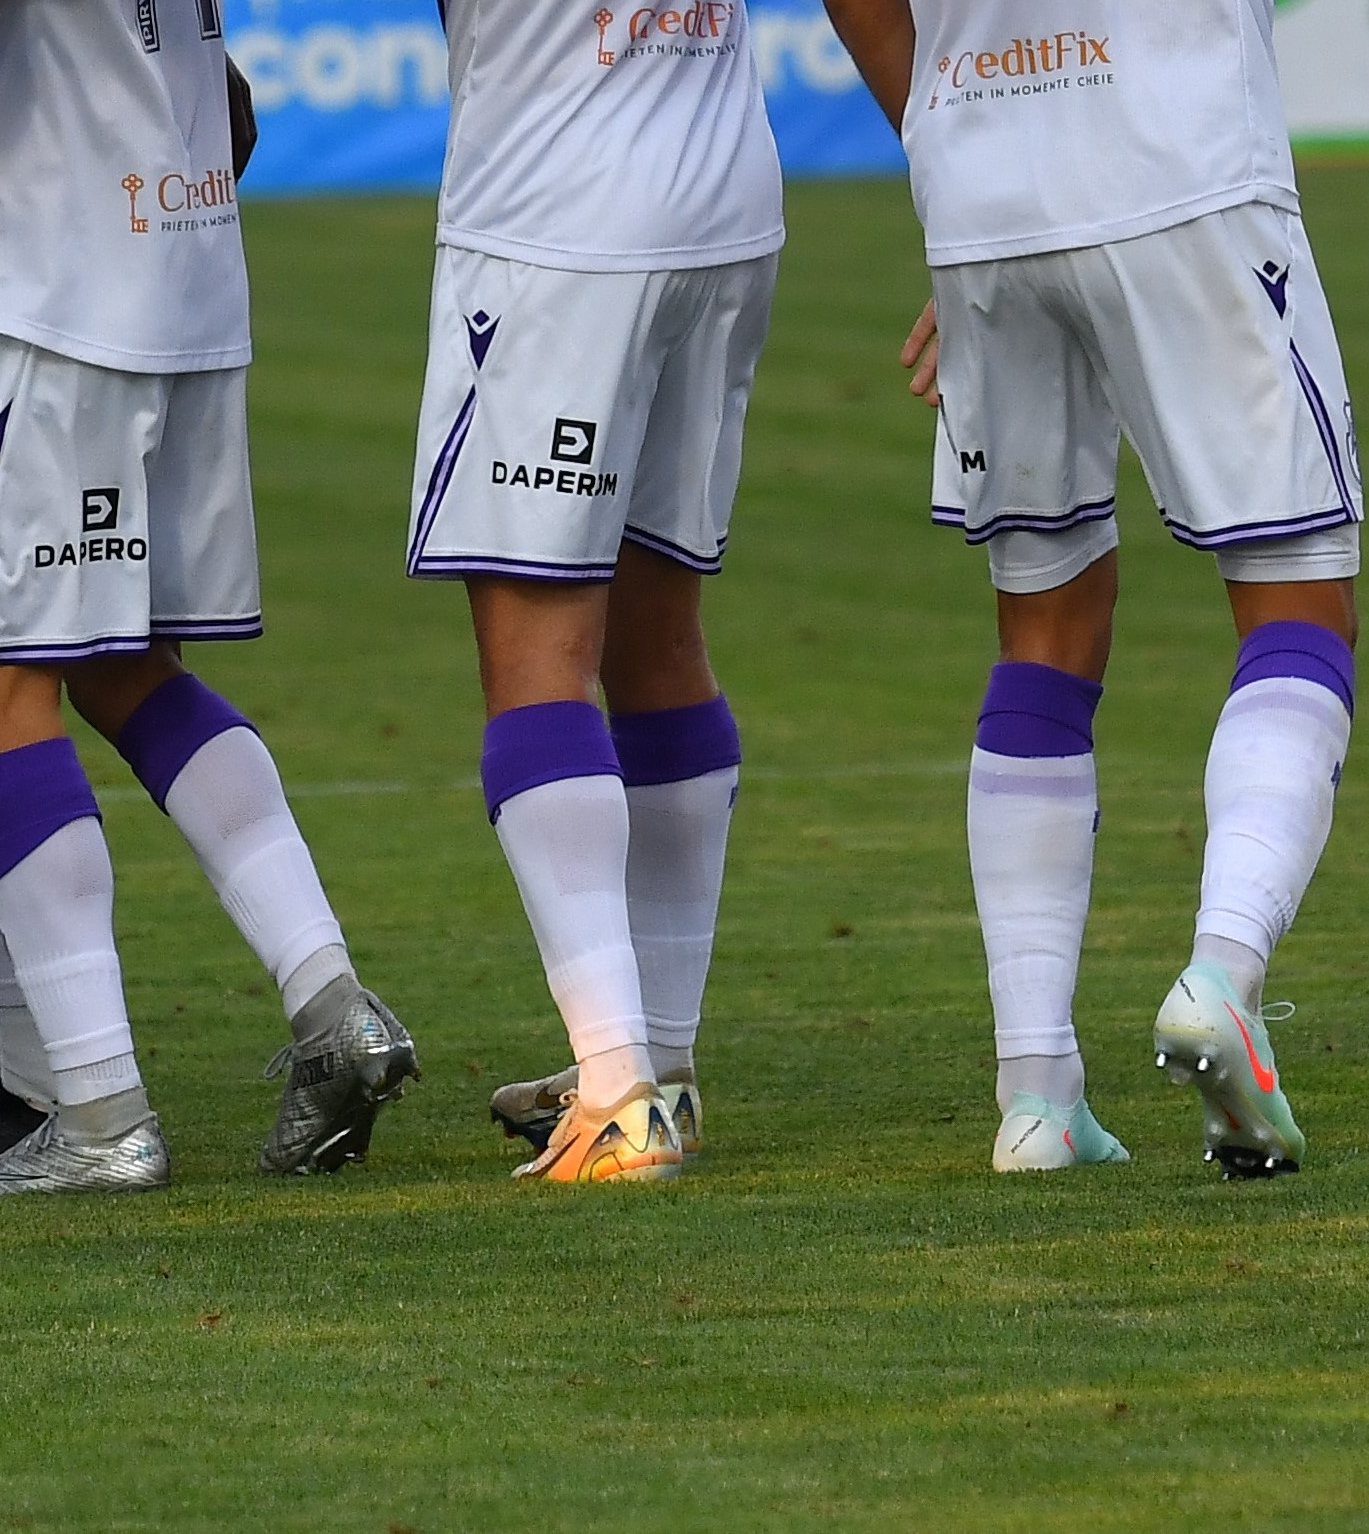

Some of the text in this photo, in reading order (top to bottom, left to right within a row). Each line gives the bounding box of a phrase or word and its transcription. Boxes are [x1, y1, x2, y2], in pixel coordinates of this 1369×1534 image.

[990, 87, 1005, 99] IN
[1011, 77, 1071, 97] MOMENTE
[1077, 73, 1115, 87] CHEIE
[157, 169, 234, 213] Credit
[34, 537, 147, 568] DAPERO
